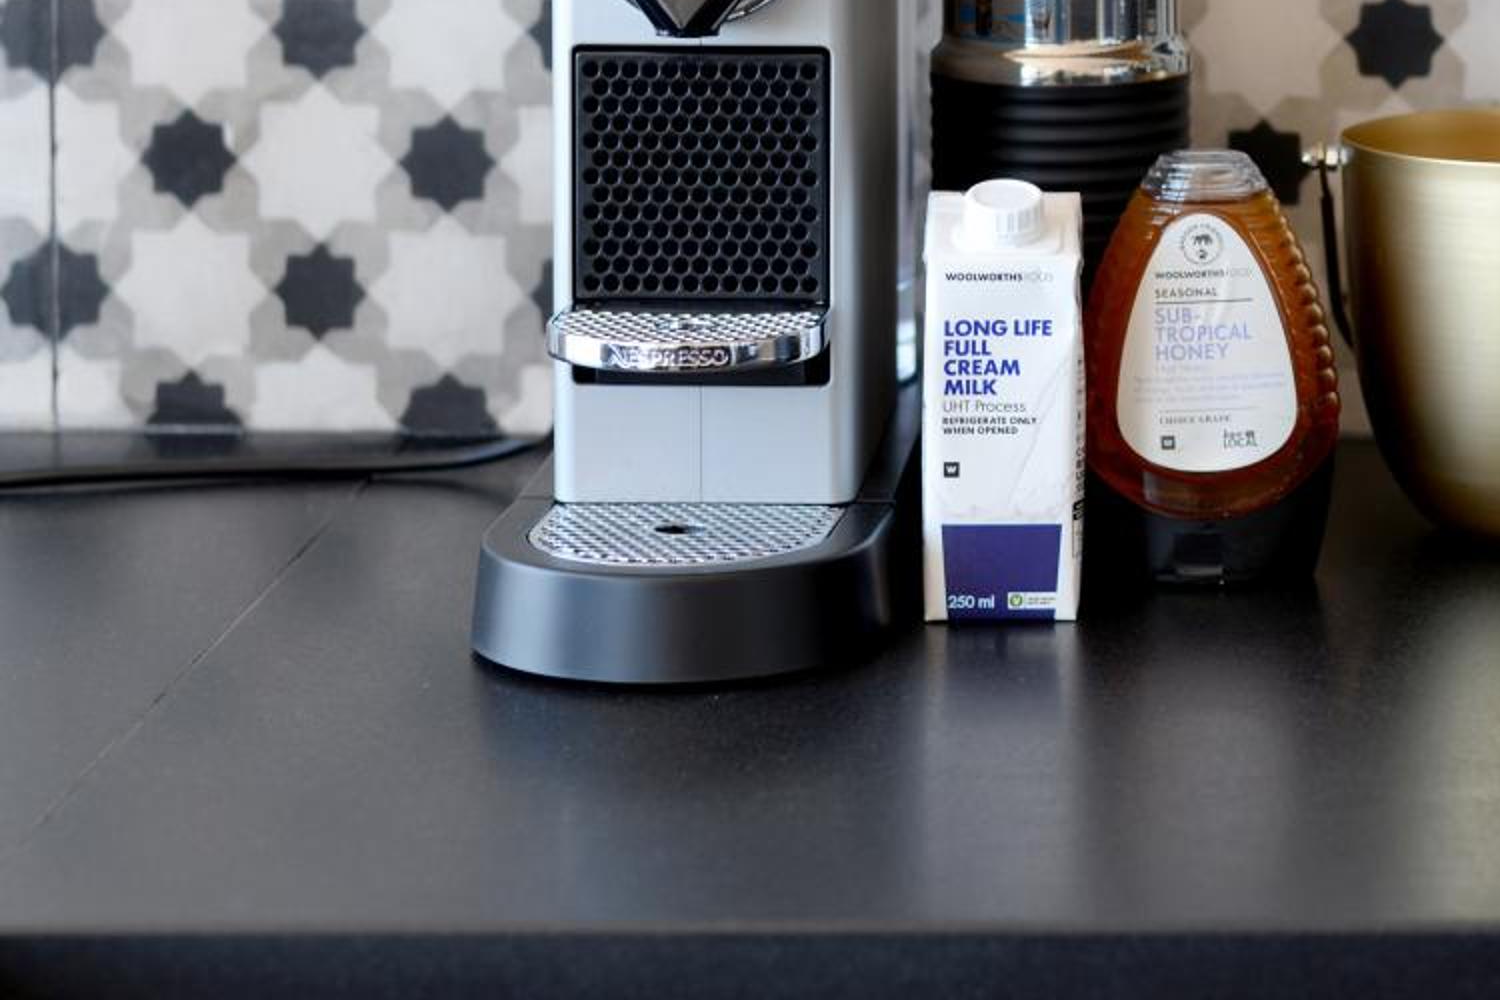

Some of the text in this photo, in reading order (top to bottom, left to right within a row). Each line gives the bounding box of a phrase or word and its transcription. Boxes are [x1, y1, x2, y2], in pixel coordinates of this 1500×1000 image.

[1155, 286, 1218, 298] SEASONAL
[1154, 307, 1201, 324] SUB-
[944, 319, 1052, 337] LONG LIFE
[1154, 320, 1253, 343] TROPICAL
[609, 344, 729, 368] NESPRESSO
[944, 339, 992, 357] FULL
[1155, 343, 1230, 361] HONEY
[943, 359, 1020, 376] CREAM
[943, 379, 997, 396] MILK
[943, 399, 1026, 413] UHT Process
[942, 415, 1037, 425] REFRIGERATE ONLY
[943, 425, 1019, 435] WHEN OPENED
[948, 594, 995, 609] 250 ml
